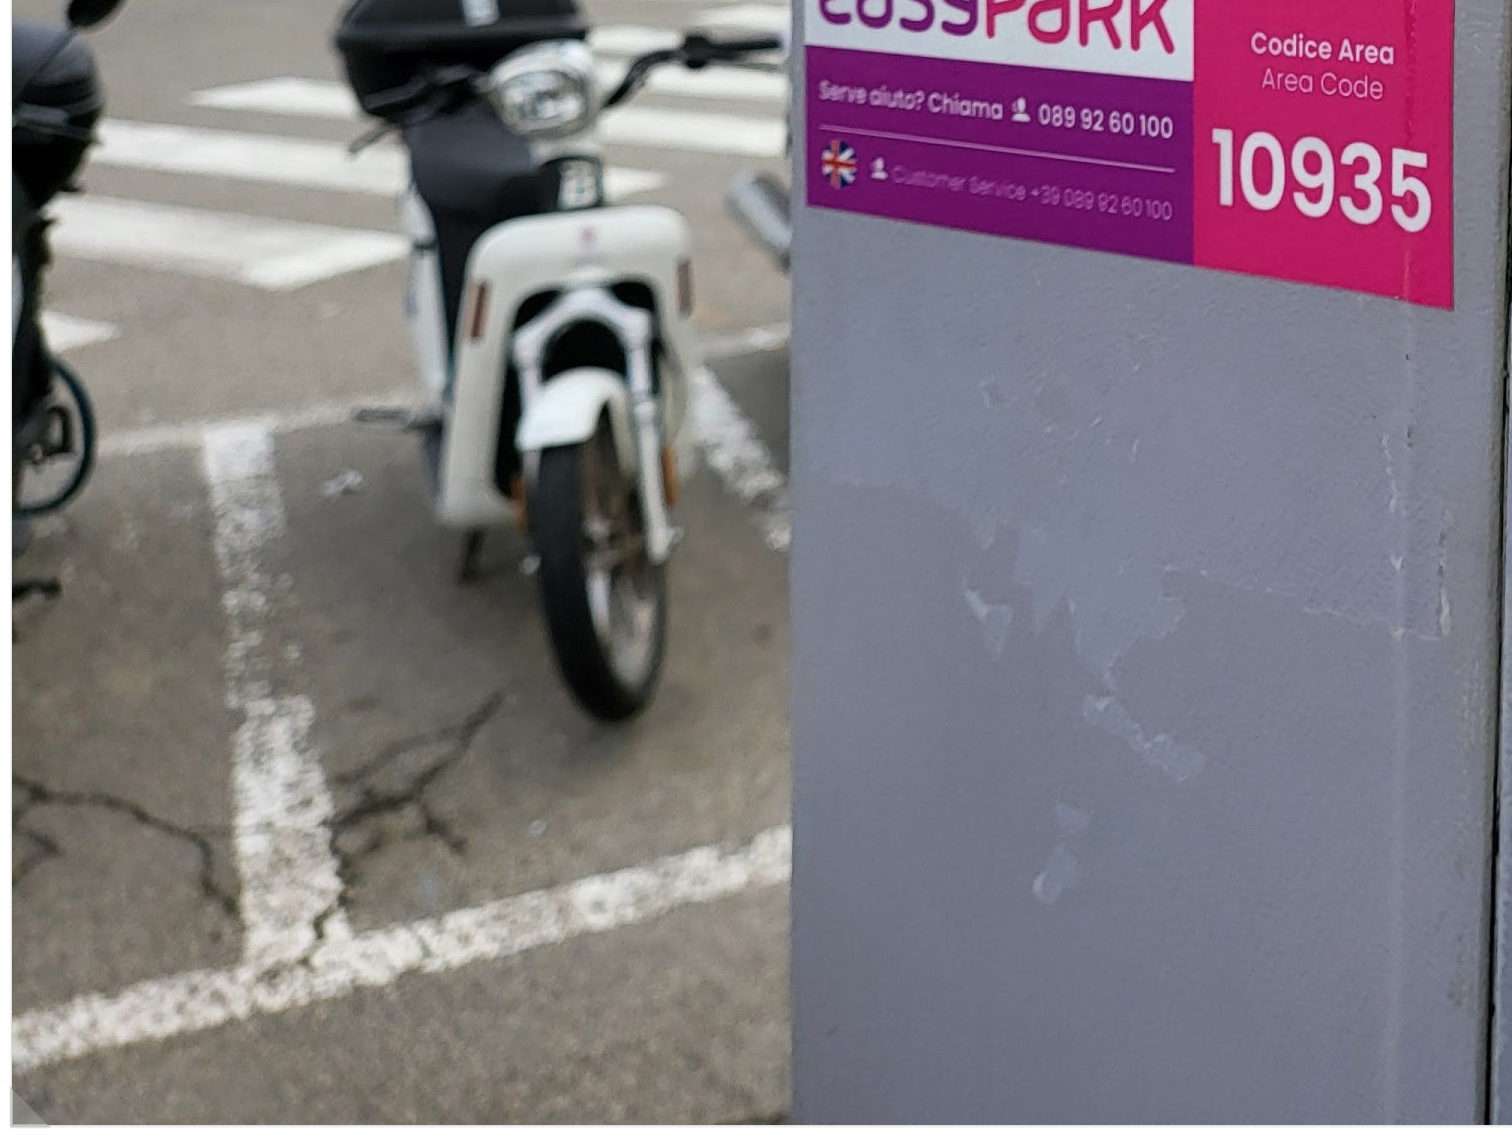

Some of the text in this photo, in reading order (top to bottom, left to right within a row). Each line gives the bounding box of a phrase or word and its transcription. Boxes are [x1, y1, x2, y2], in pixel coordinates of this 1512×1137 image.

[1250, 31, 1395, 65] Codice Area
[1261, 66, 1384, 101] Area Code
[817, 79, 1174, 139] Serve aiuto? Chiama 089 92 60 100
[1211, 127, 1432, 233] 10935
[1144, 199, 1174, 221] 100
